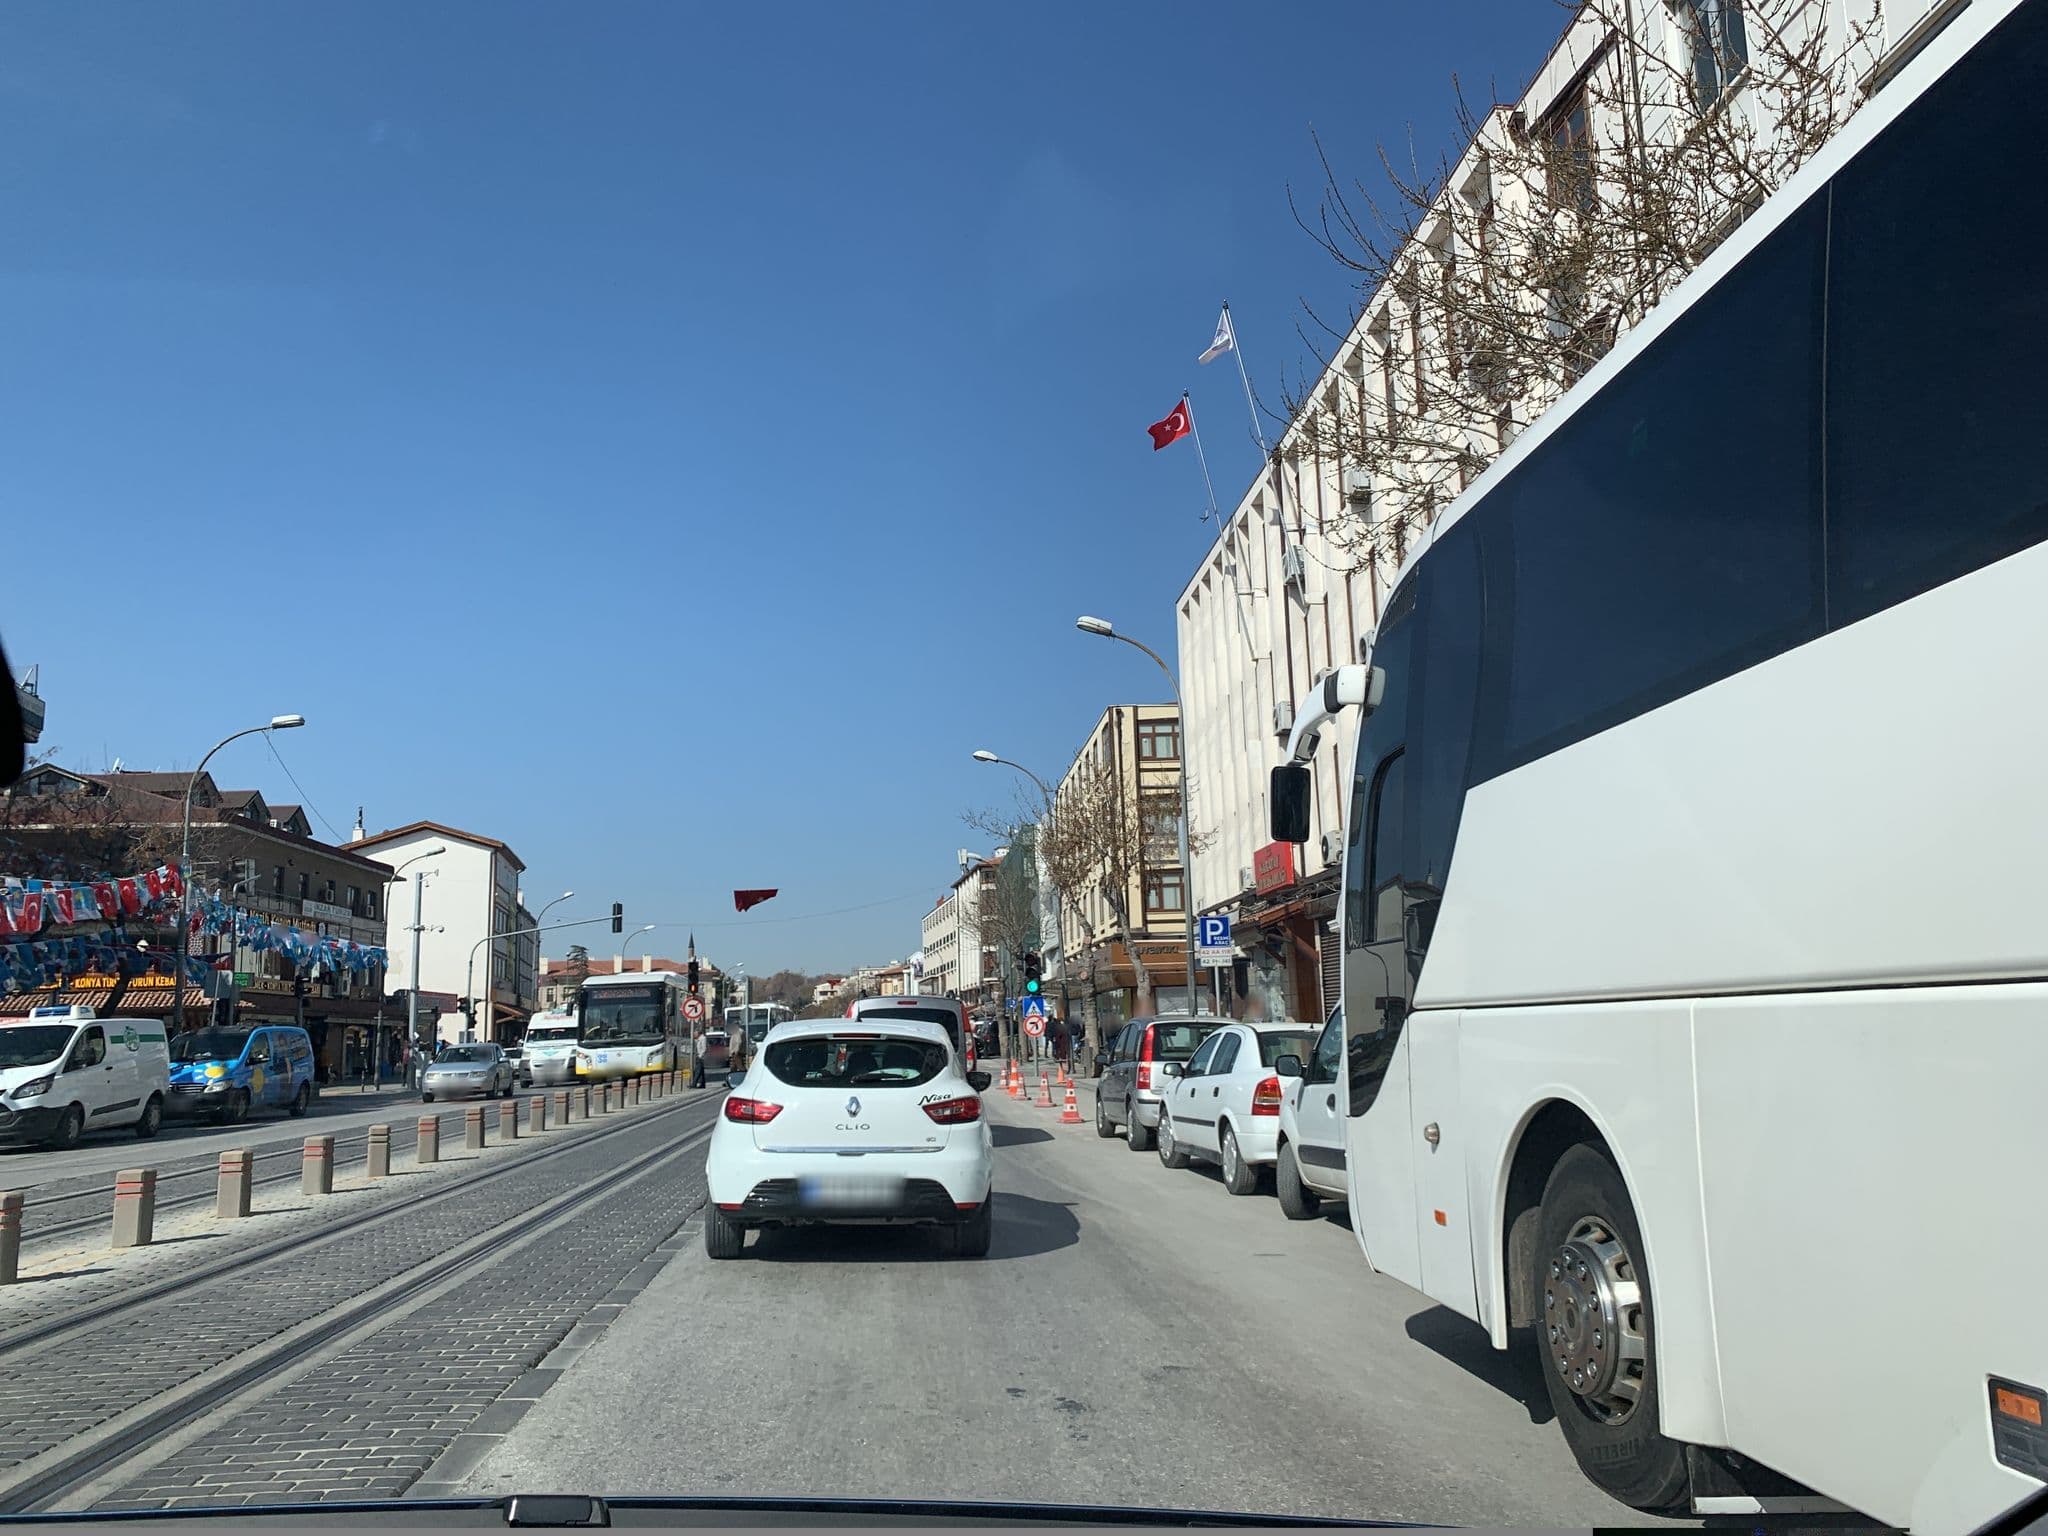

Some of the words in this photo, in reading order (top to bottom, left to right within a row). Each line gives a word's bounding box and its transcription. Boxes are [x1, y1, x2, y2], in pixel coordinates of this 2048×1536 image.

[1206, 919, 1224, 944] P
[75, 977, 102, 988] KONYA
[917, 1094, 951, 1106] Nisa
[835, 1123, 870, 1131] CLIO
